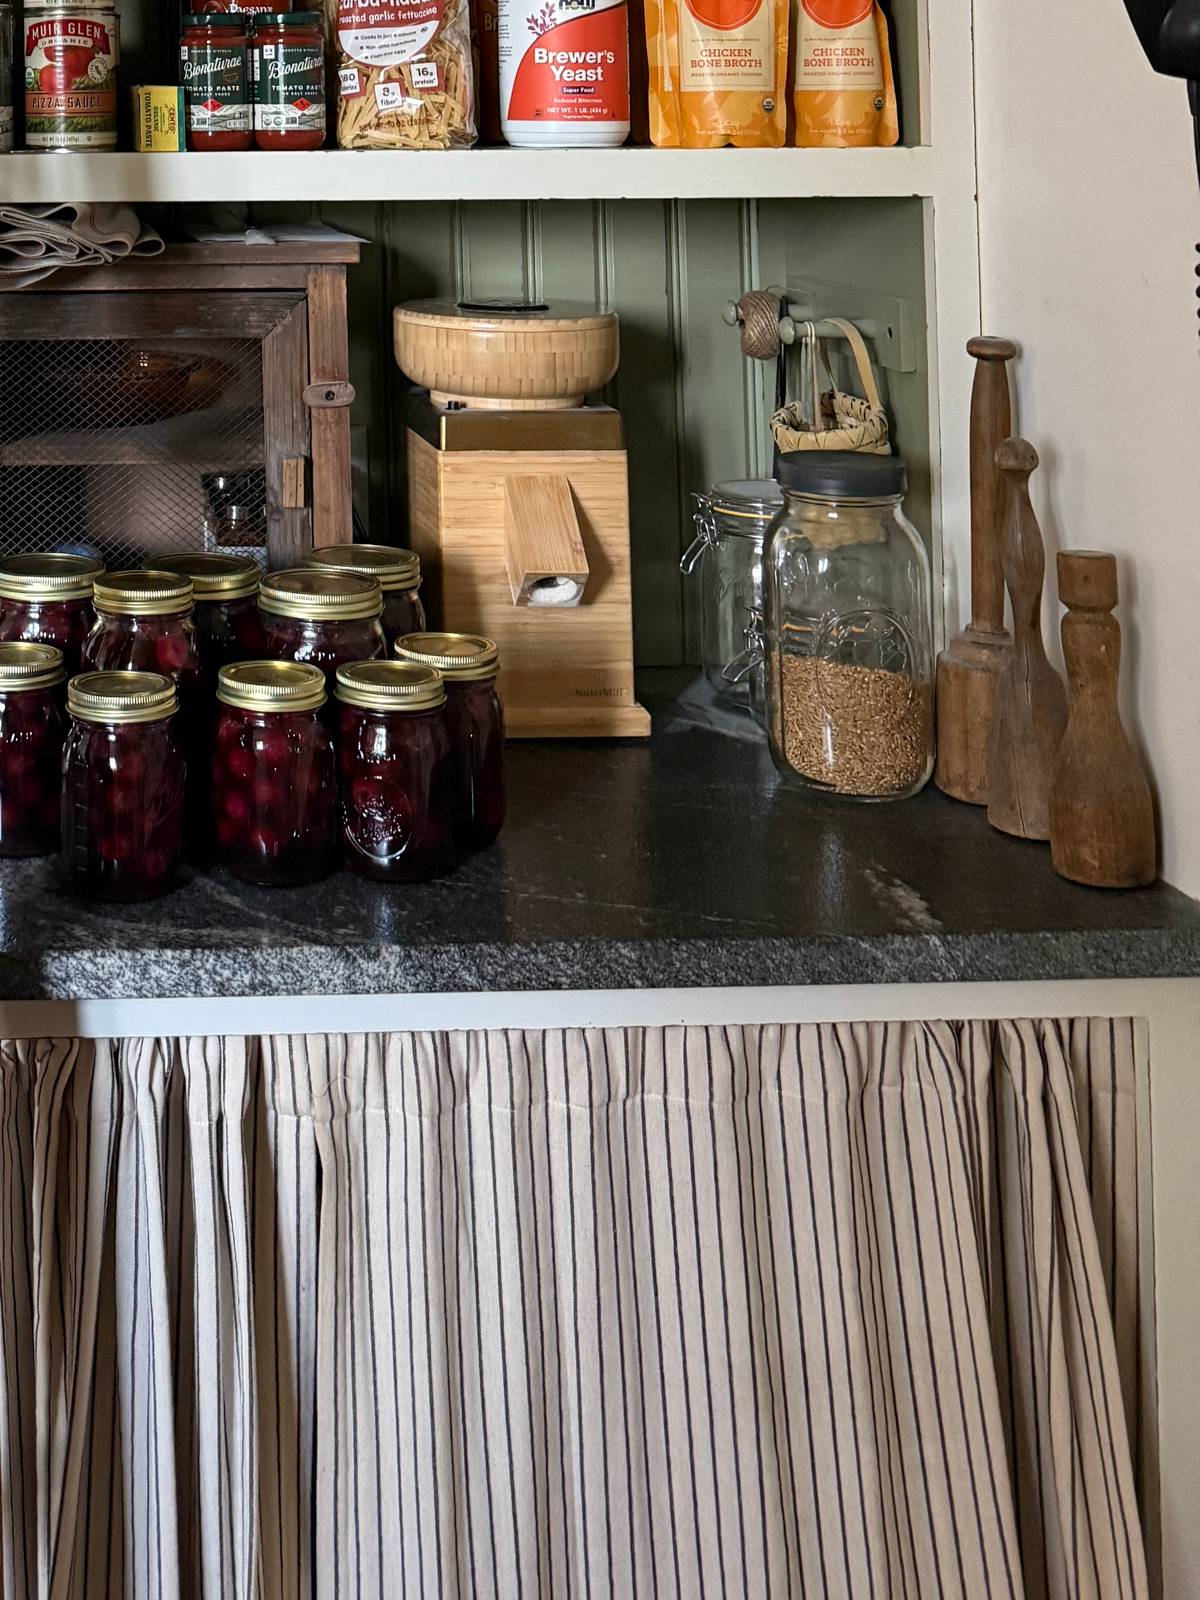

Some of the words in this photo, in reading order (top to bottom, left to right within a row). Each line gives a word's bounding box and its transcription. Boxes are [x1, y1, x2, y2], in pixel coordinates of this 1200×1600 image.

[369, 11, 395, 24] garlic
[398, 7, 438, 20] fettuccine
[32, 23, 60, 41] MUIR
[68, 22, 100, 39] GLEN
[534, 48, 615, 64] Brewer's
[700, 48, 752, 57] CHICKEN
[813, 47, 865, 57] CHICKEN
[183, 56, 242, 80] Bionaturae
[691, 59, 722, 68] BONE
[723, 58, 762, 68] BROTH
[803, 58, 833, 67] BONE
[836, 58, 874, 67] BROTH
[550, 65, 603, 82] Yeast
[32, 98, 62, 109] PIZZA
[67, 97, 102, 108] SAUCE
[145, 125, 153, 148] PASTE
